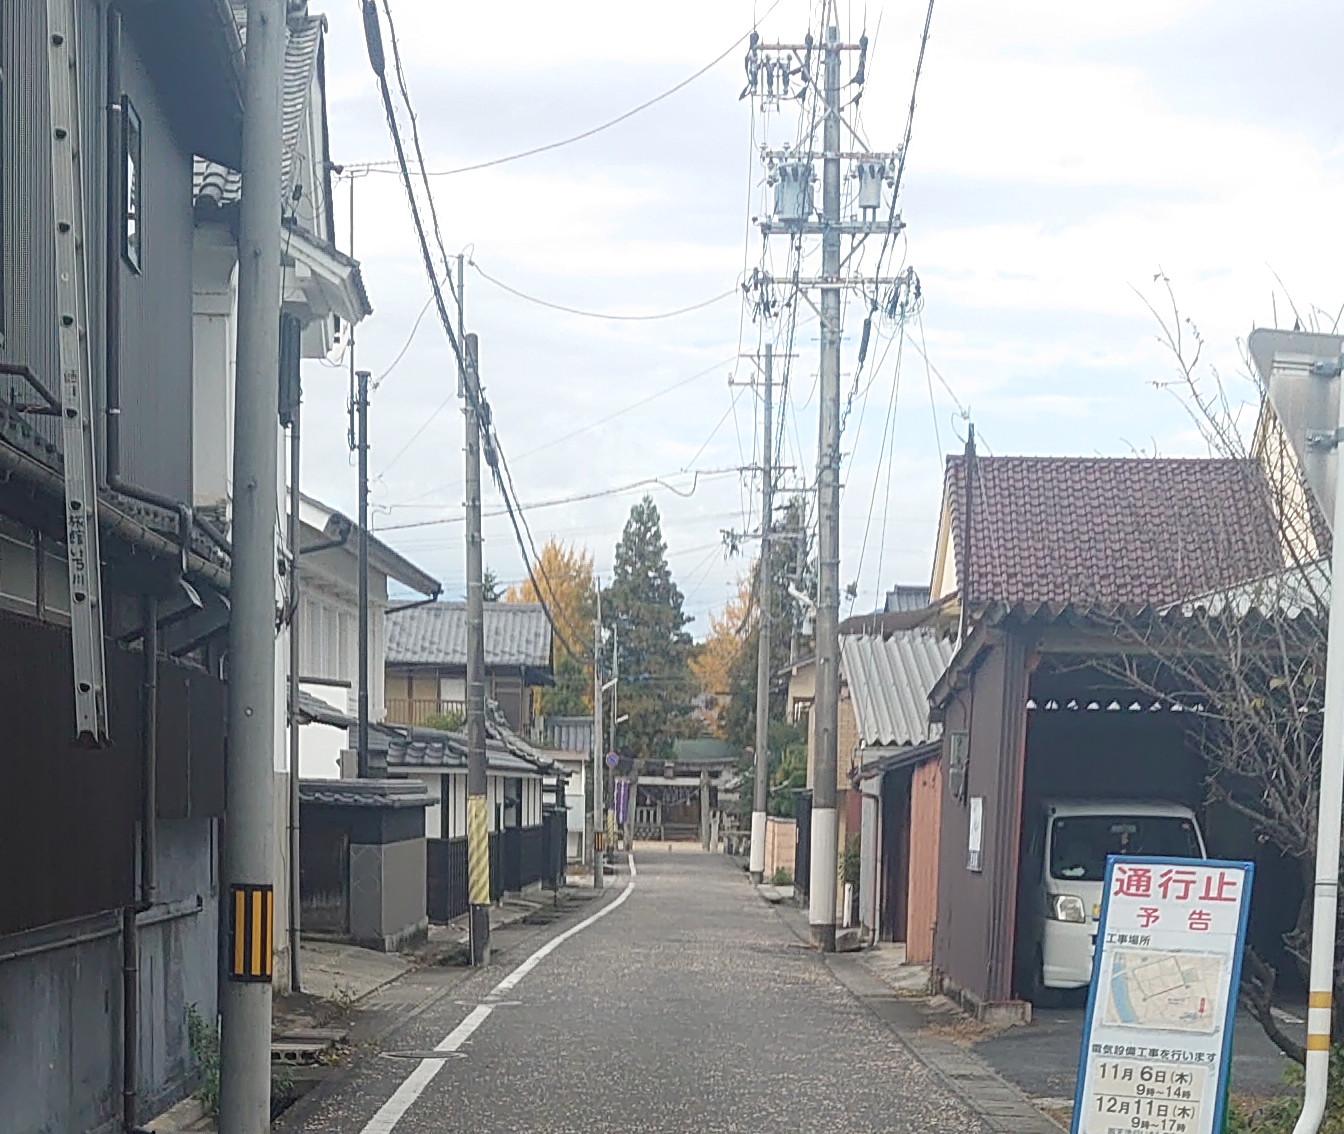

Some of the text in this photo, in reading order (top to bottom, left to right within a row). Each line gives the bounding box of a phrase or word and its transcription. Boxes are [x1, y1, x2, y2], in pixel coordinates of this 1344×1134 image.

[1114, 866, 1237, 902] 通行止
[1106, 933, 1151, 946] 工事場所
[1091, 1043, 1217, 1063] 電気設備工事を行います
